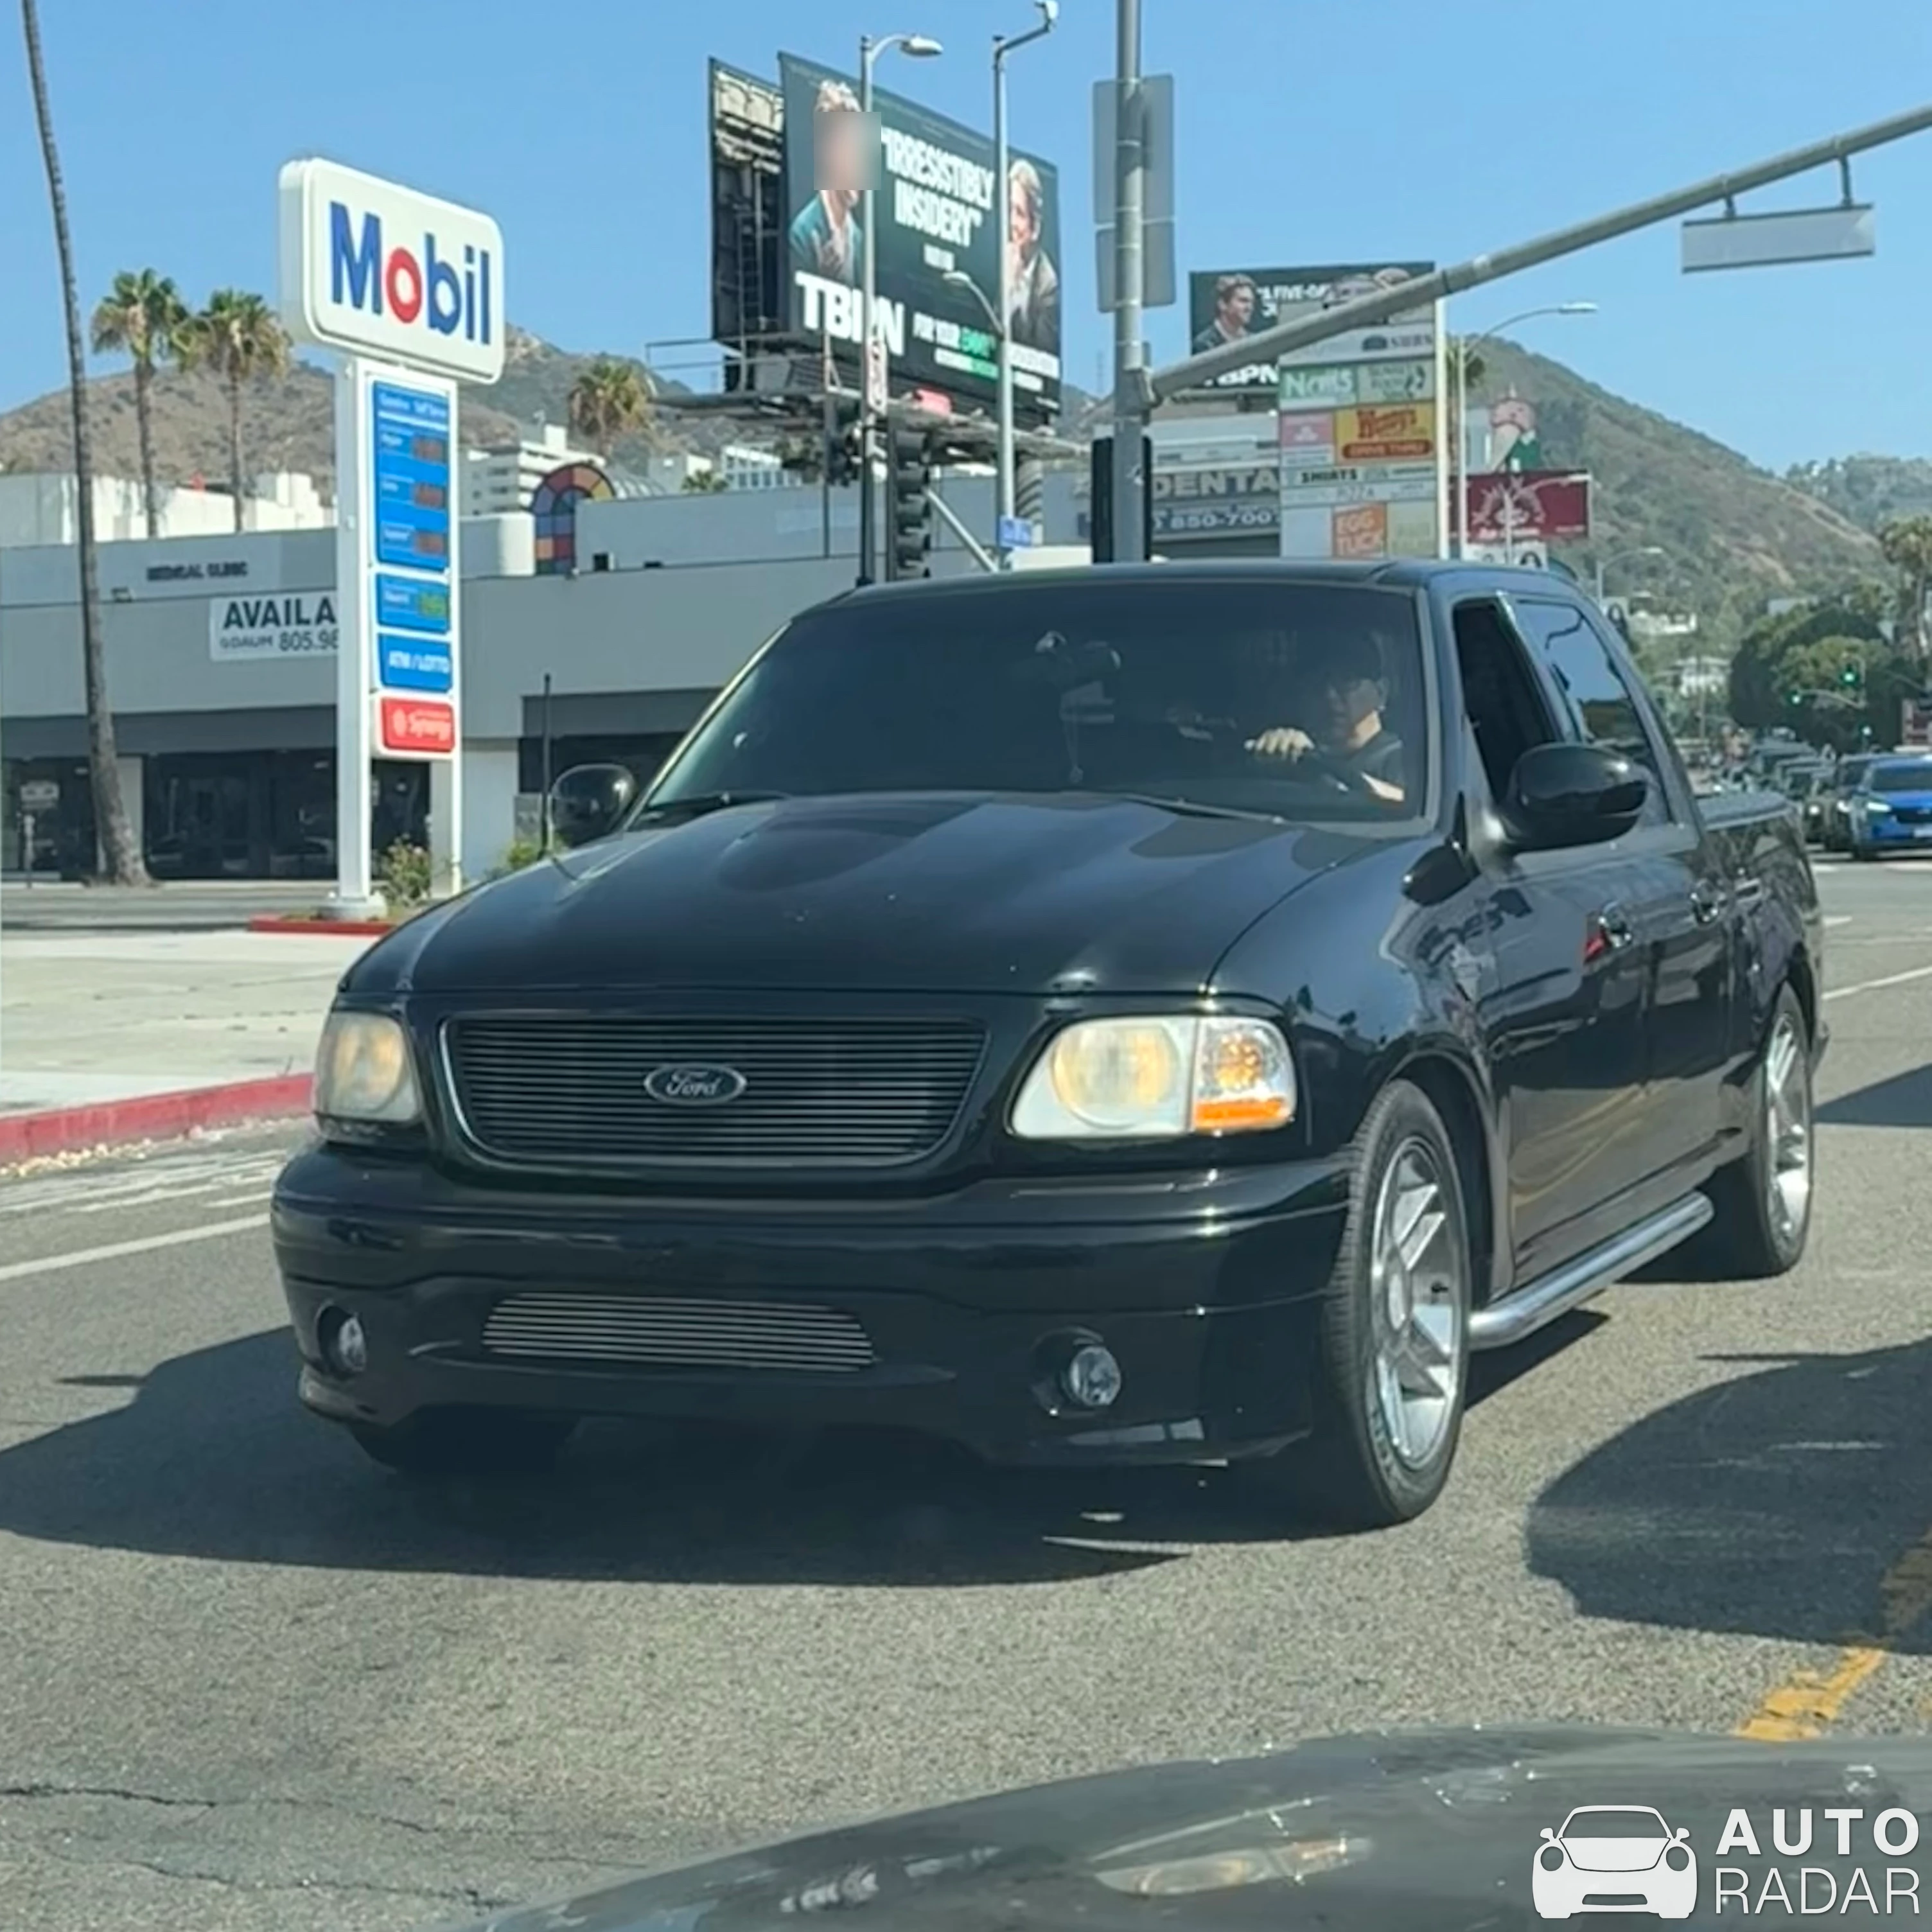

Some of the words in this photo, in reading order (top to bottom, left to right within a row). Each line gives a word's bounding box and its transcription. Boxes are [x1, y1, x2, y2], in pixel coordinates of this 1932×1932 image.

[329, 200, 491, 346] Mobil
[1204, 364, 1279, 385] BPN
[1170, 510, 1279, 529] 850-700
[223, 597, 337, 629] AVAILA
[665, 1070, 723, 1096] Ford
